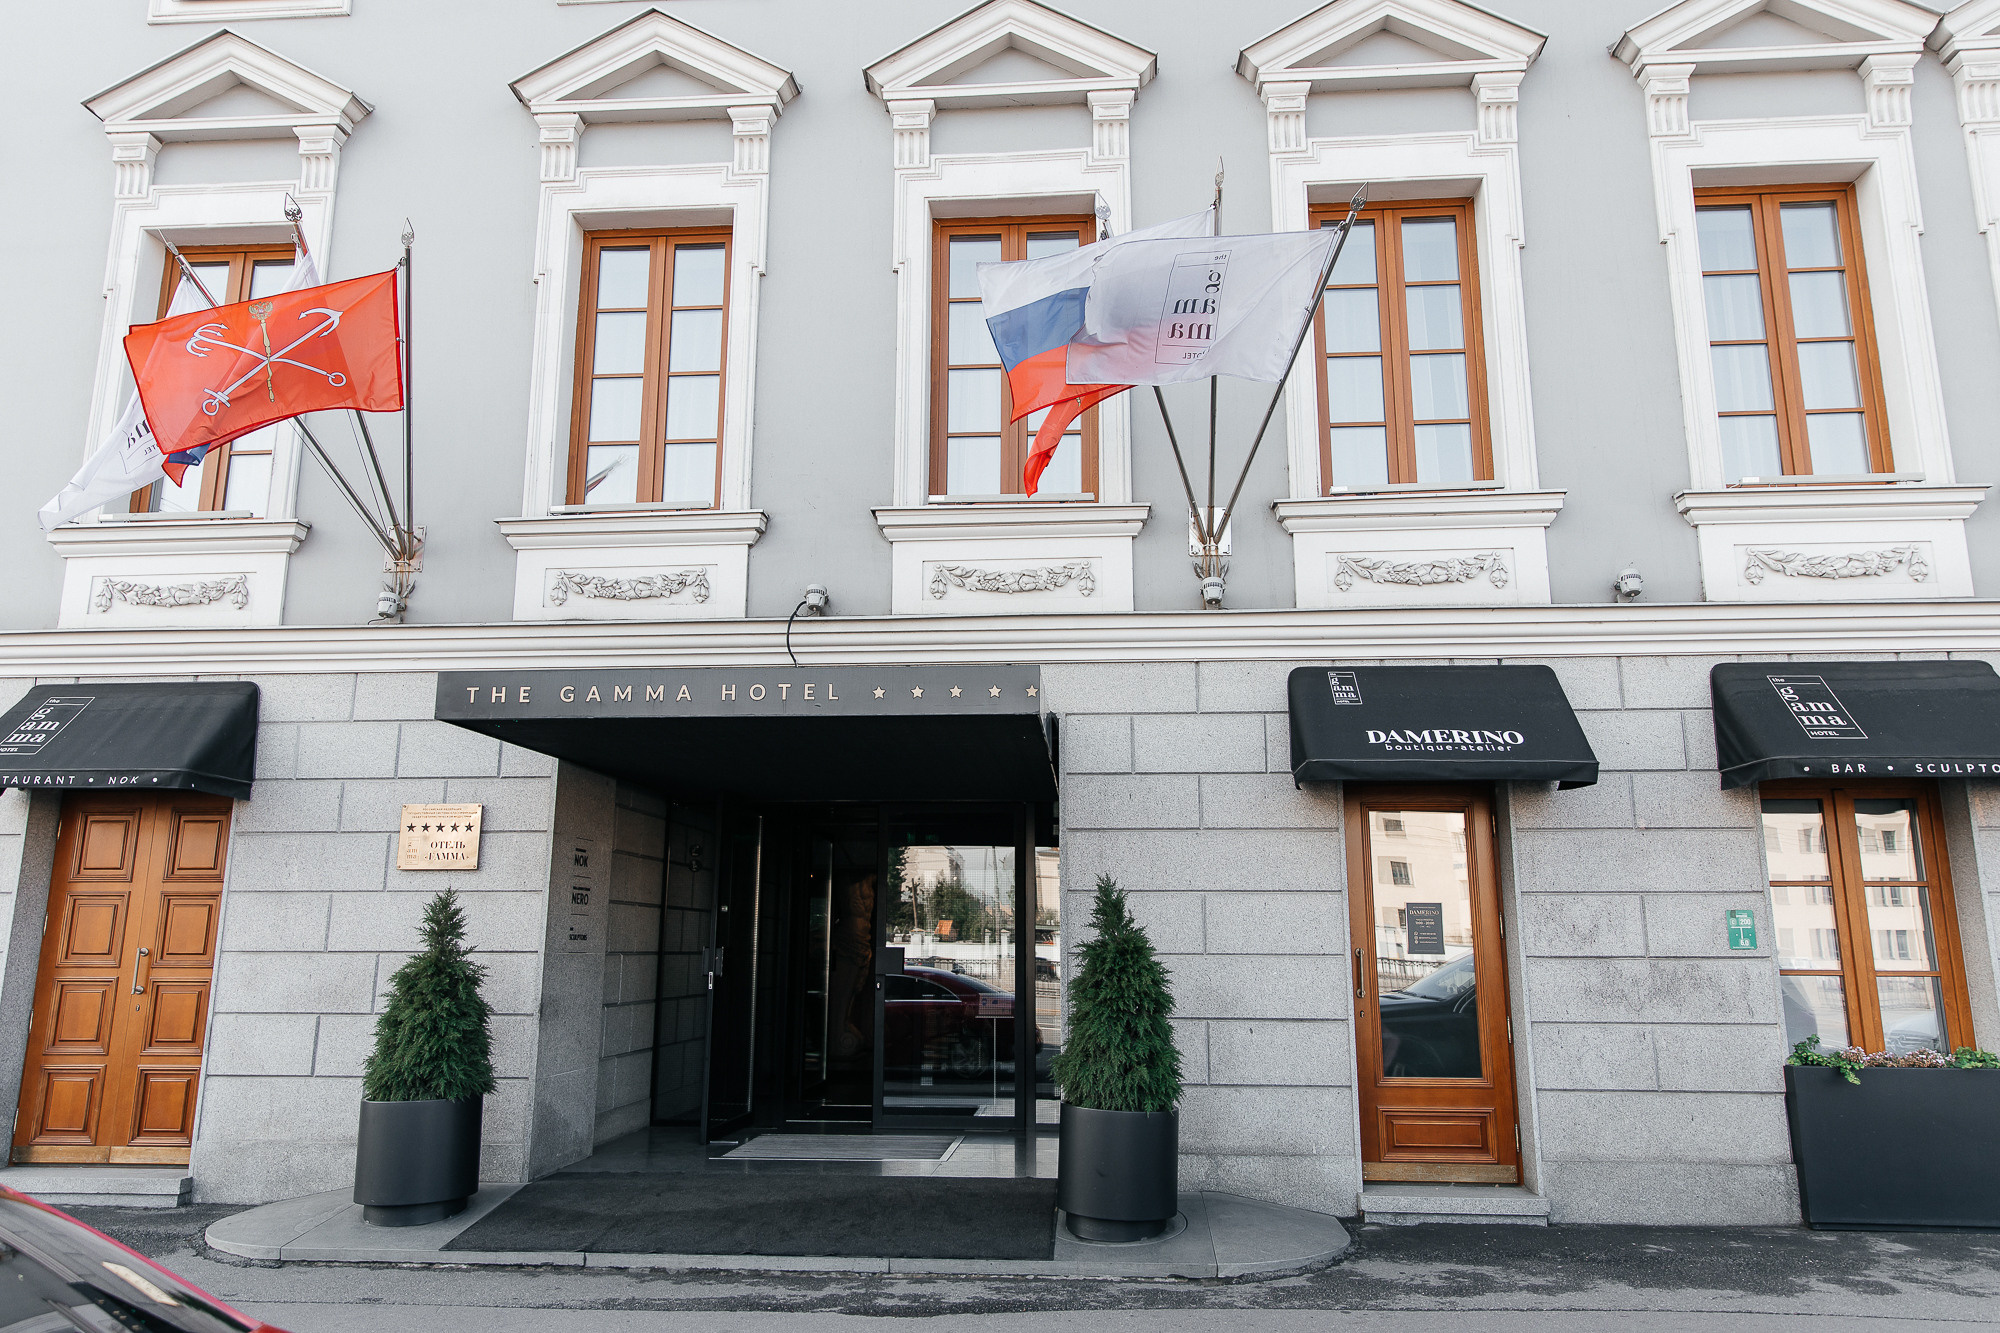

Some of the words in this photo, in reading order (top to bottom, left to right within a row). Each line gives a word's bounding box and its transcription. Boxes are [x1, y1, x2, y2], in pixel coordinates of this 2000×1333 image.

[466, 685, 532, 704] THE
[559, 684, 693, 703] GAMMA
[721, 682, 840, 702] HOTEL
[1780, 686, 1800, 702] g
[1790, 701, 1838, 712] am
[20, 721, 60, 730] am
[1798, 715, 1848, 726] ma
[5, 734, 46, 743] ma
[1365, 729, 1525, 745] DAMERINO
[1385, 743, 1512, 752] boutique-atelier
[1831, 763, 1867, 774] BAR
[108, 776, 139, 785] NOK
[430, 840, 466, 849] ОТЕЛЬ
[574, 854, 589, 867] NOK
[571, 893, 589, 905] NERO
